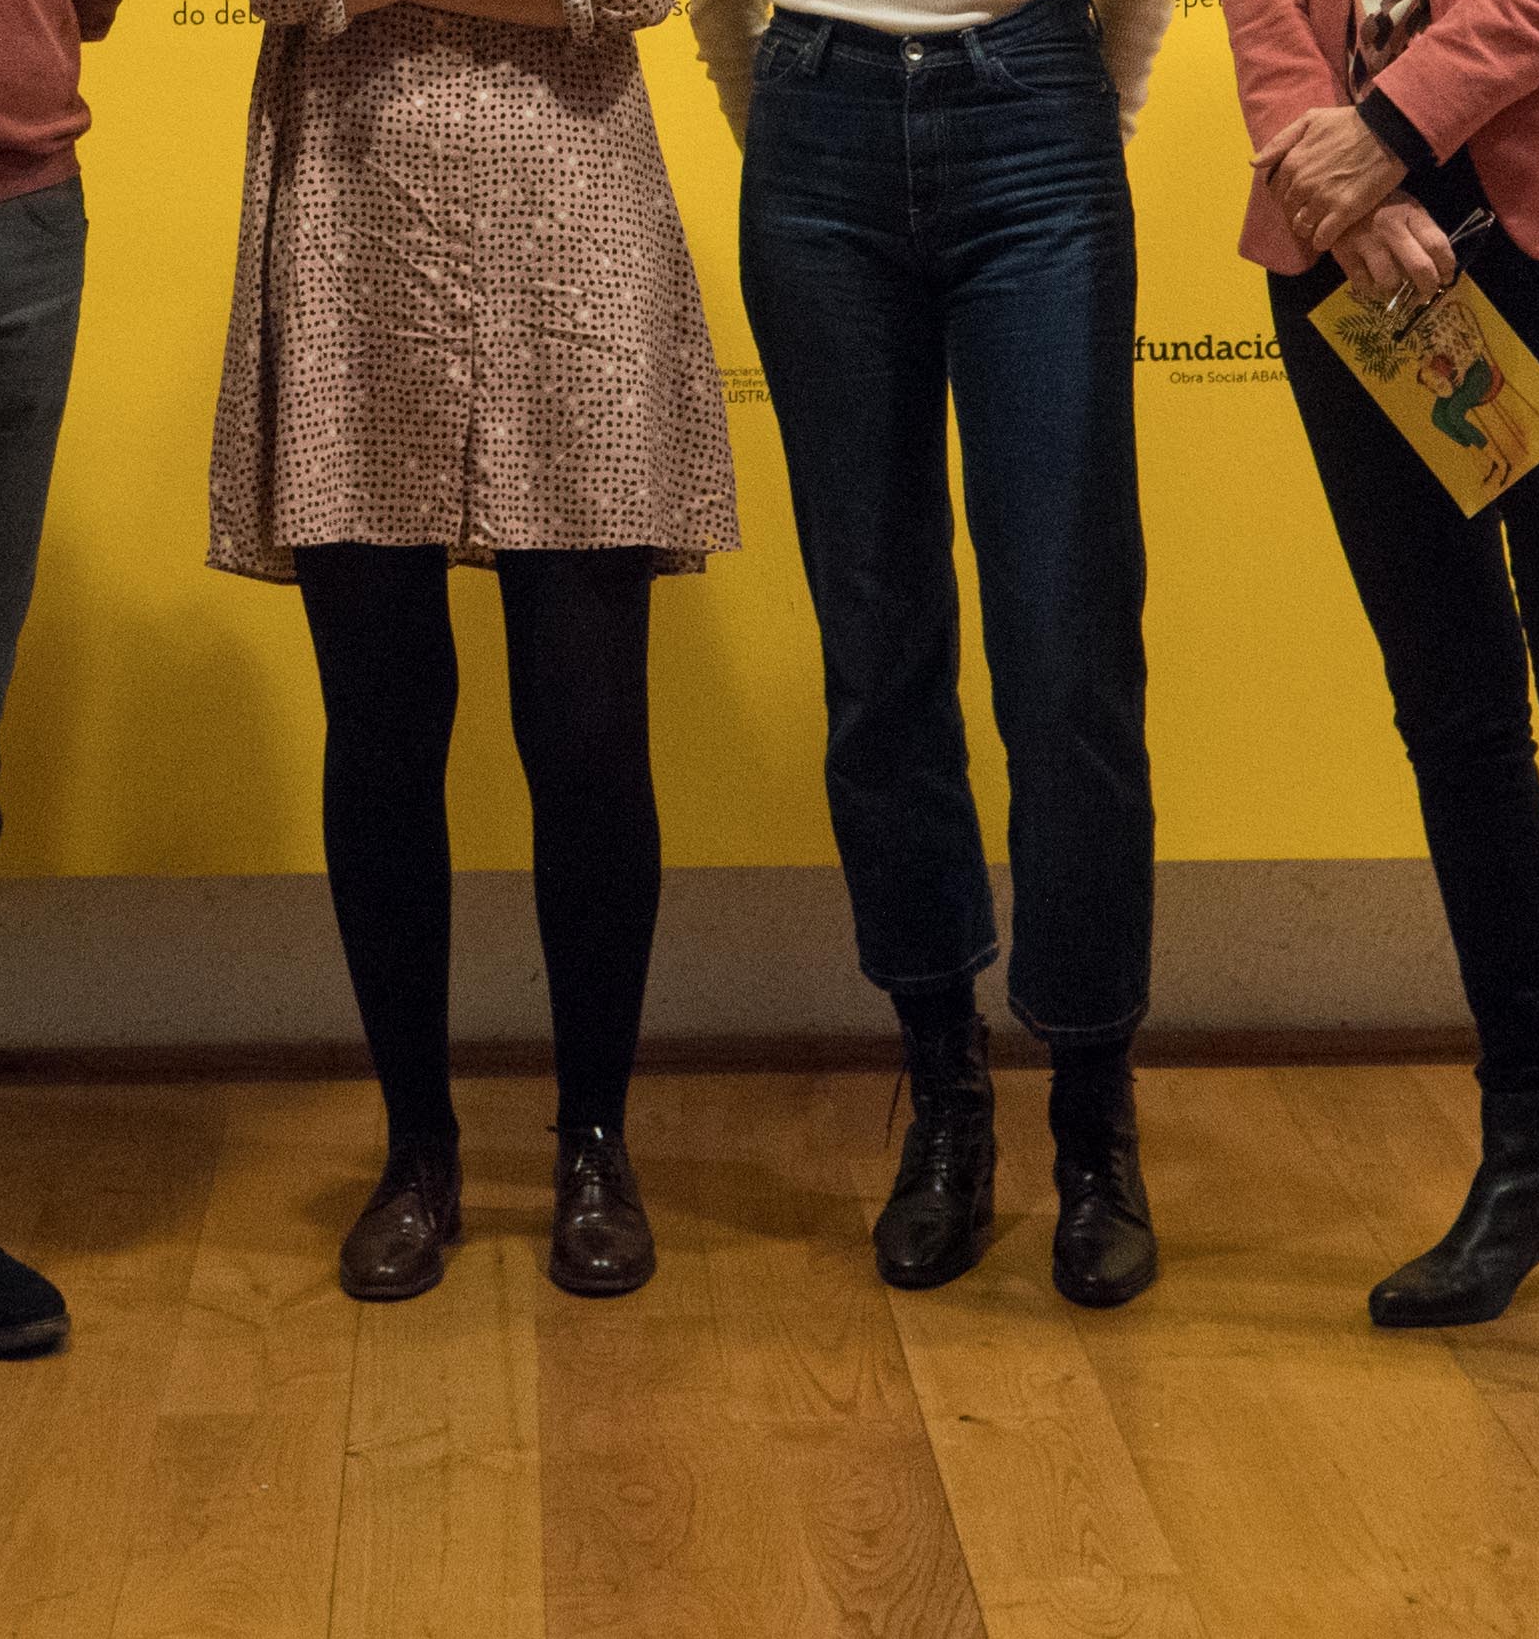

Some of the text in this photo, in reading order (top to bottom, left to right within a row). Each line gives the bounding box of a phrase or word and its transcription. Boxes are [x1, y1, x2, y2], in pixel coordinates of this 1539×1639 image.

[172, 0, 206, 27] do
[1134, 333, 1283, 362] fundació
[1169, 370, 1204, 385] Obra
[1207, 369, 1248, 384] Social
